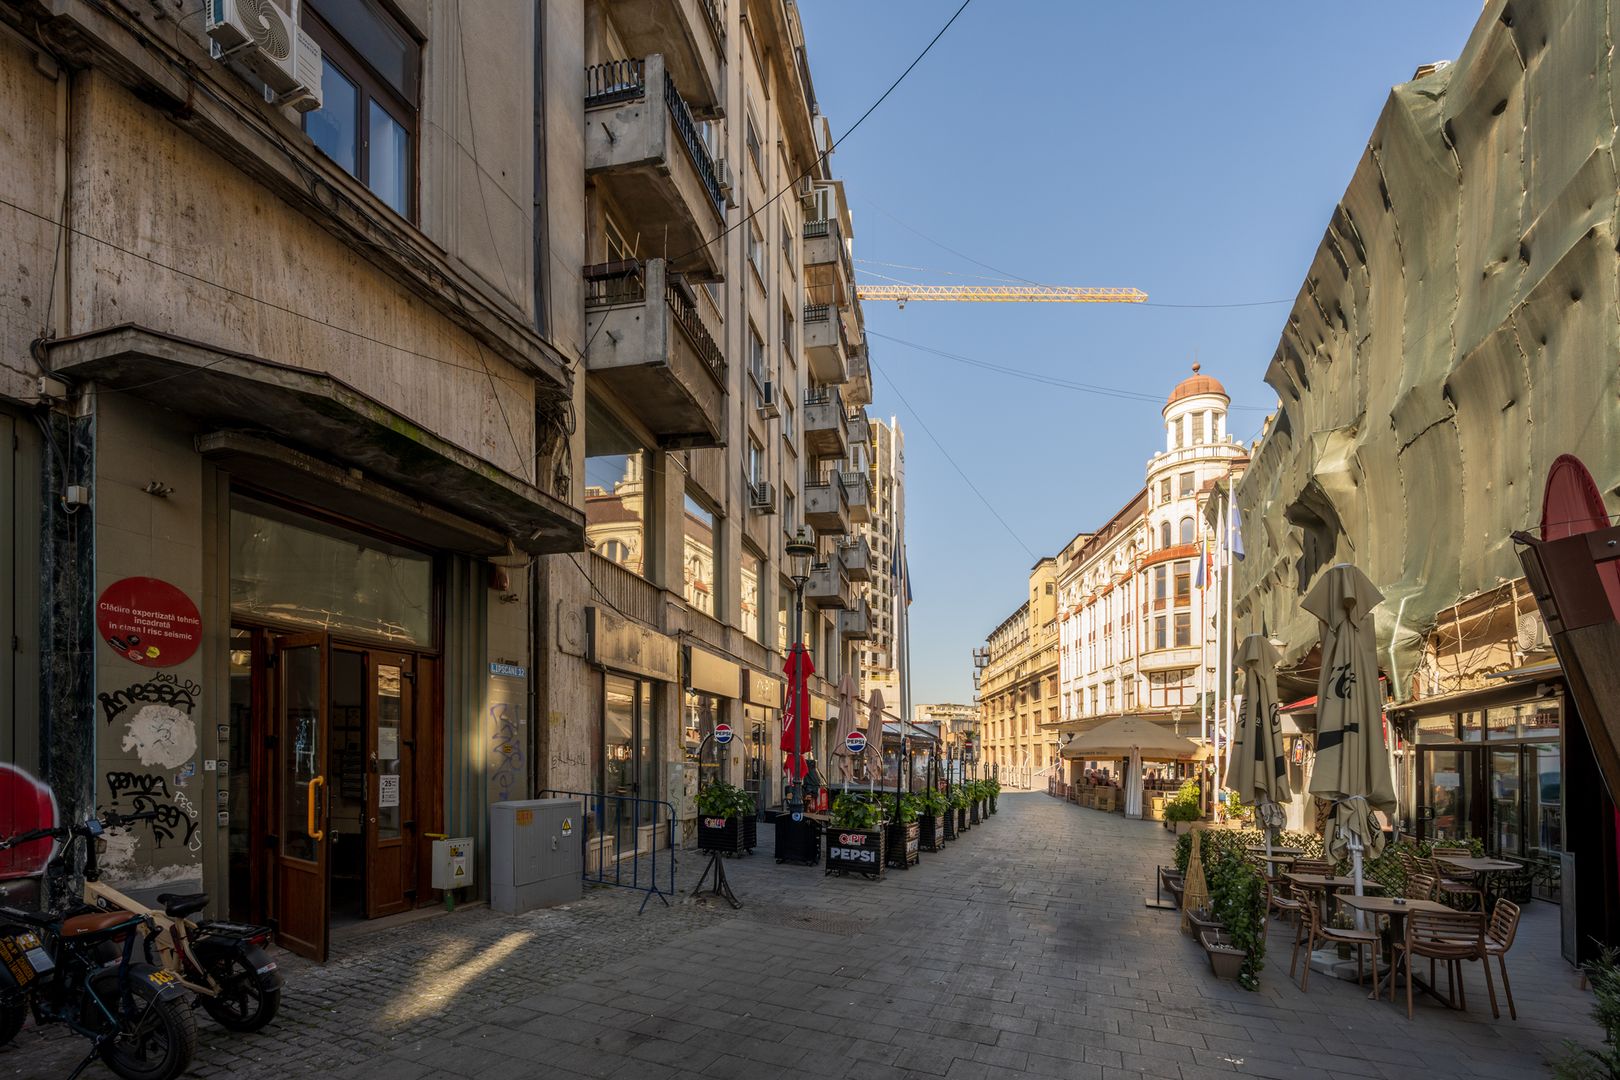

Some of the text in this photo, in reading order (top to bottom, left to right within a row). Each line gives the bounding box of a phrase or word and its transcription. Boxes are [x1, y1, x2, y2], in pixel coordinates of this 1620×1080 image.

[132, 609, 176, 621] expertizată
[177, 615, 200, 625] tehnic
[148, 628, 164, 636] risc
[164, 630, 192, 640] seismic
[491, 664, 518, 676] LIPSCANI
[830, 848, 875, 862] PEPSI
